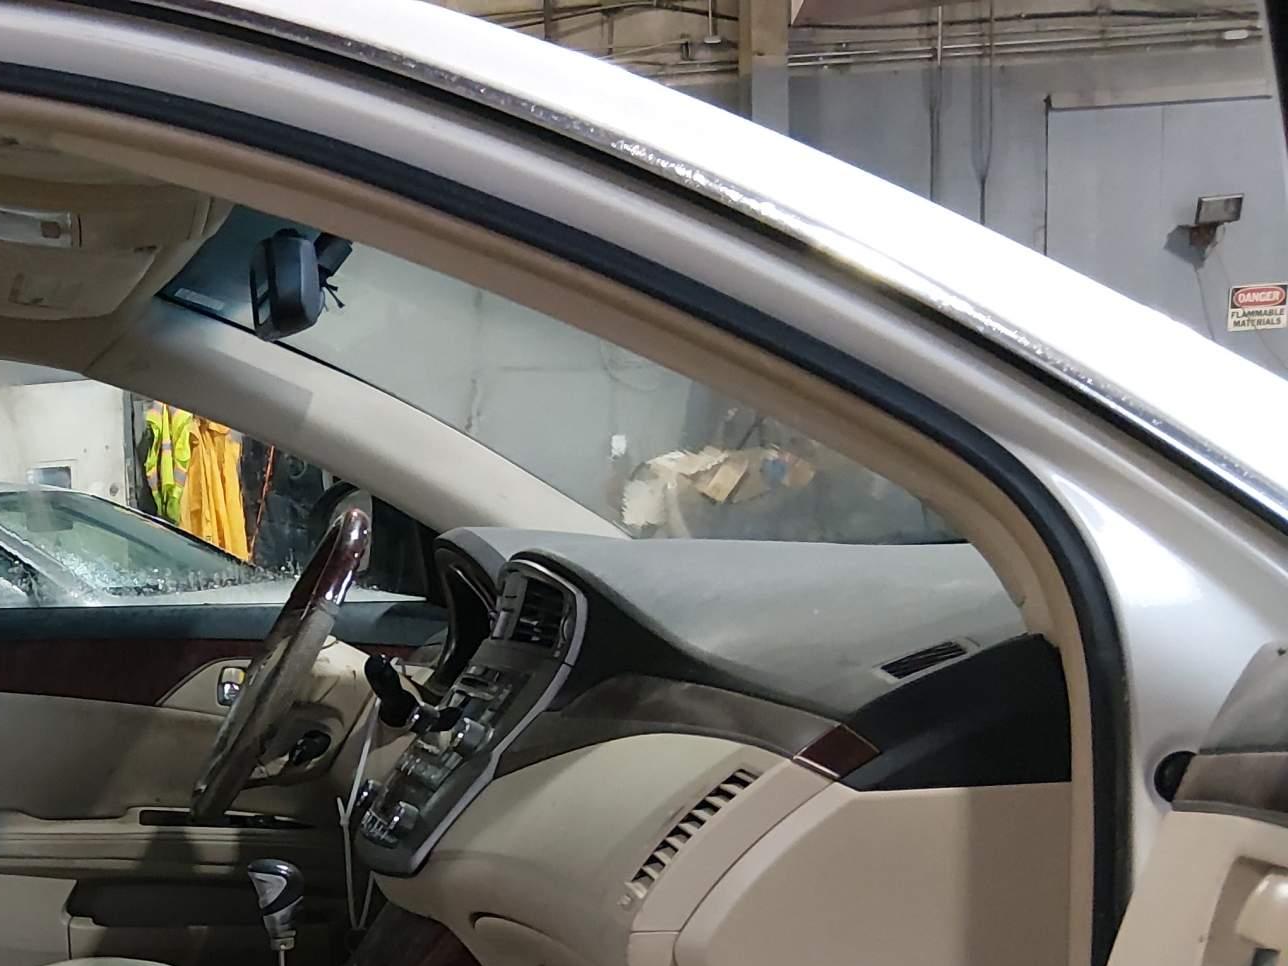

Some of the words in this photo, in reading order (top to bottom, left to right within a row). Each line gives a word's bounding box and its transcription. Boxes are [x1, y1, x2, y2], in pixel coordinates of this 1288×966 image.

[1238, 290, 1281, 303] DANGER
[1231, 308, 1285, 318] FLAMMABLE
[1233, 317, 1281, 327] MATERIALS
